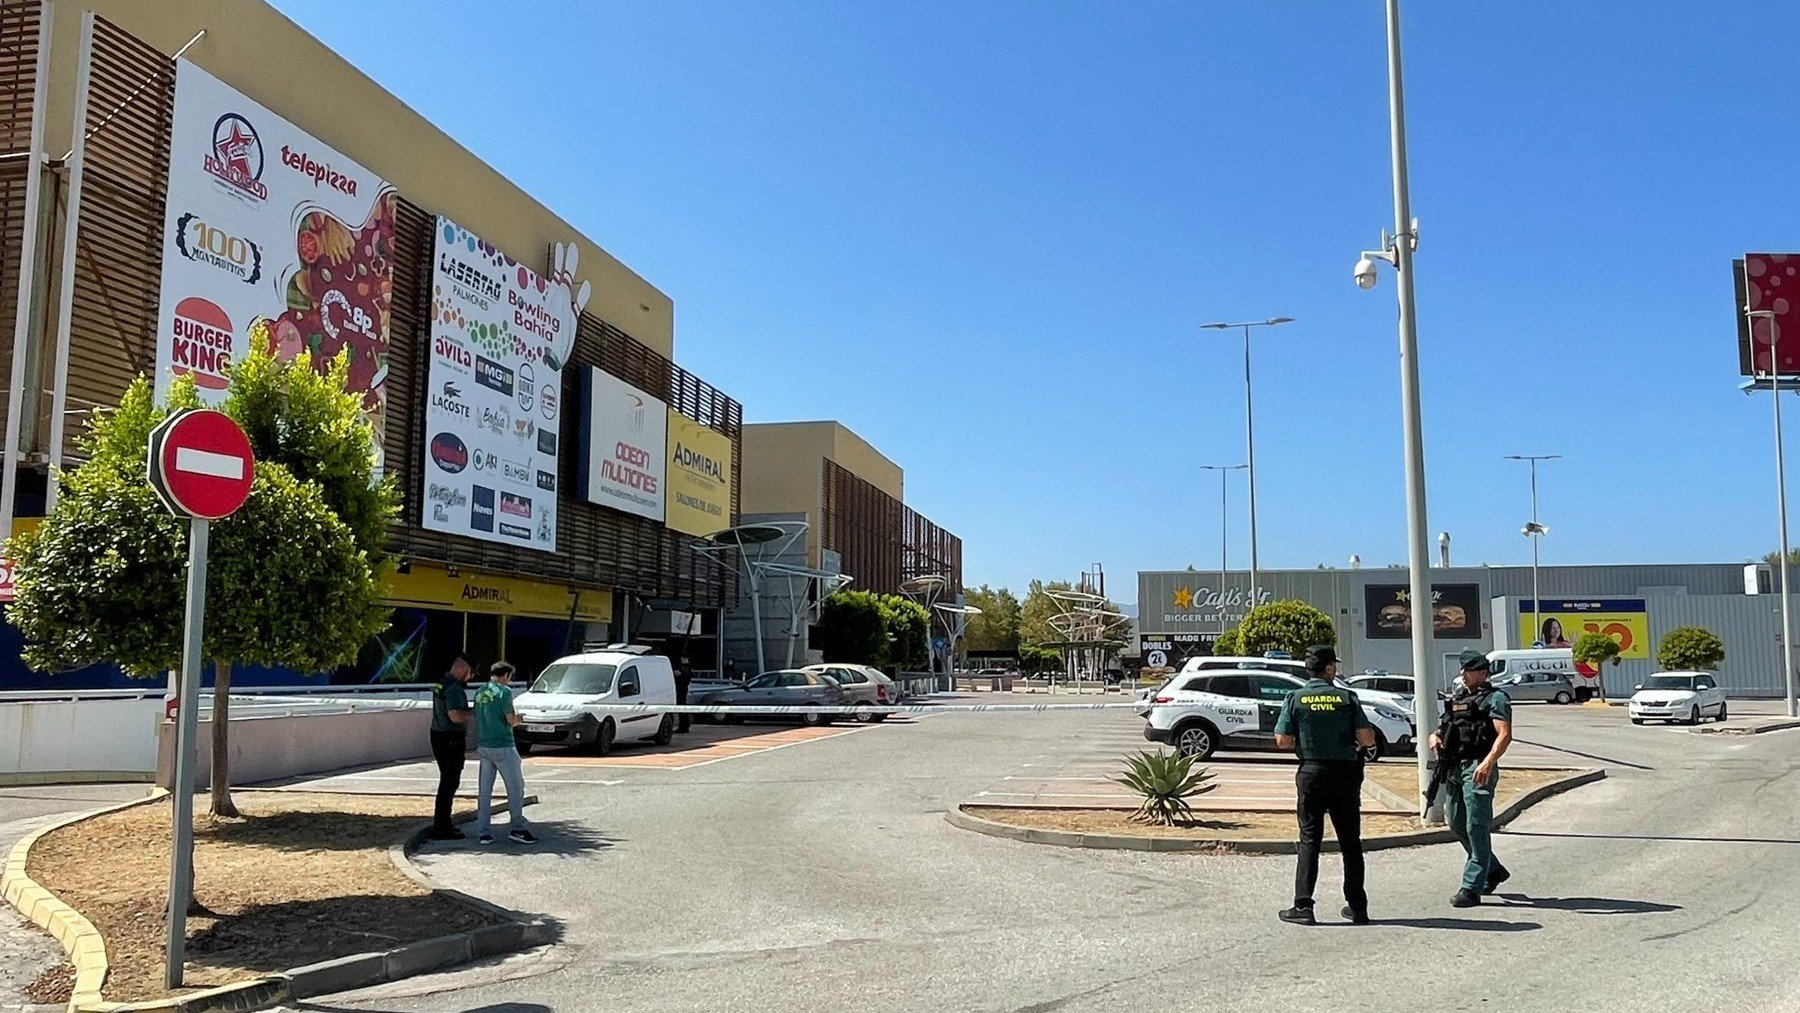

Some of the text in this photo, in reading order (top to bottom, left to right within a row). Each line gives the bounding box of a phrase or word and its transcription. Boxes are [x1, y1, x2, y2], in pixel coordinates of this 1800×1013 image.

[281, 145, 359, 198] telepizza
[193, 222, 247, 265] 100
[191, 246, 246, 278] MONTADITOS
[440, 252, 502, 302] LASERTAG
[453, 285, 489, 312] PALMONES
[508, 288, 560, 333] Bowling
[173, 317, 233, 353] BURGER
[172, 337, 233, 376] KING
[432, 394, 470, 418] LACOSTE
[673, 442, 726, 484] ADMIRAL
[601, 459, 658, 495] MULTICINES
[462, 583, 514, 605] ADMIRAL
[1192, 587, 1242, 609] Carl's
[1163, 613, 1203, 622] BIGGER
[1142, 641, 1173, 650] DOBLES
[1174, 634, 1200, 642] MADE
[1218, 707, 1253, 716] GUARDIA
[1300, 695, 1343, 704] GUARDIA
[1310, 703, 1336, 712] CIVIL
[1226, 716, 1245, 724] CIVIL
